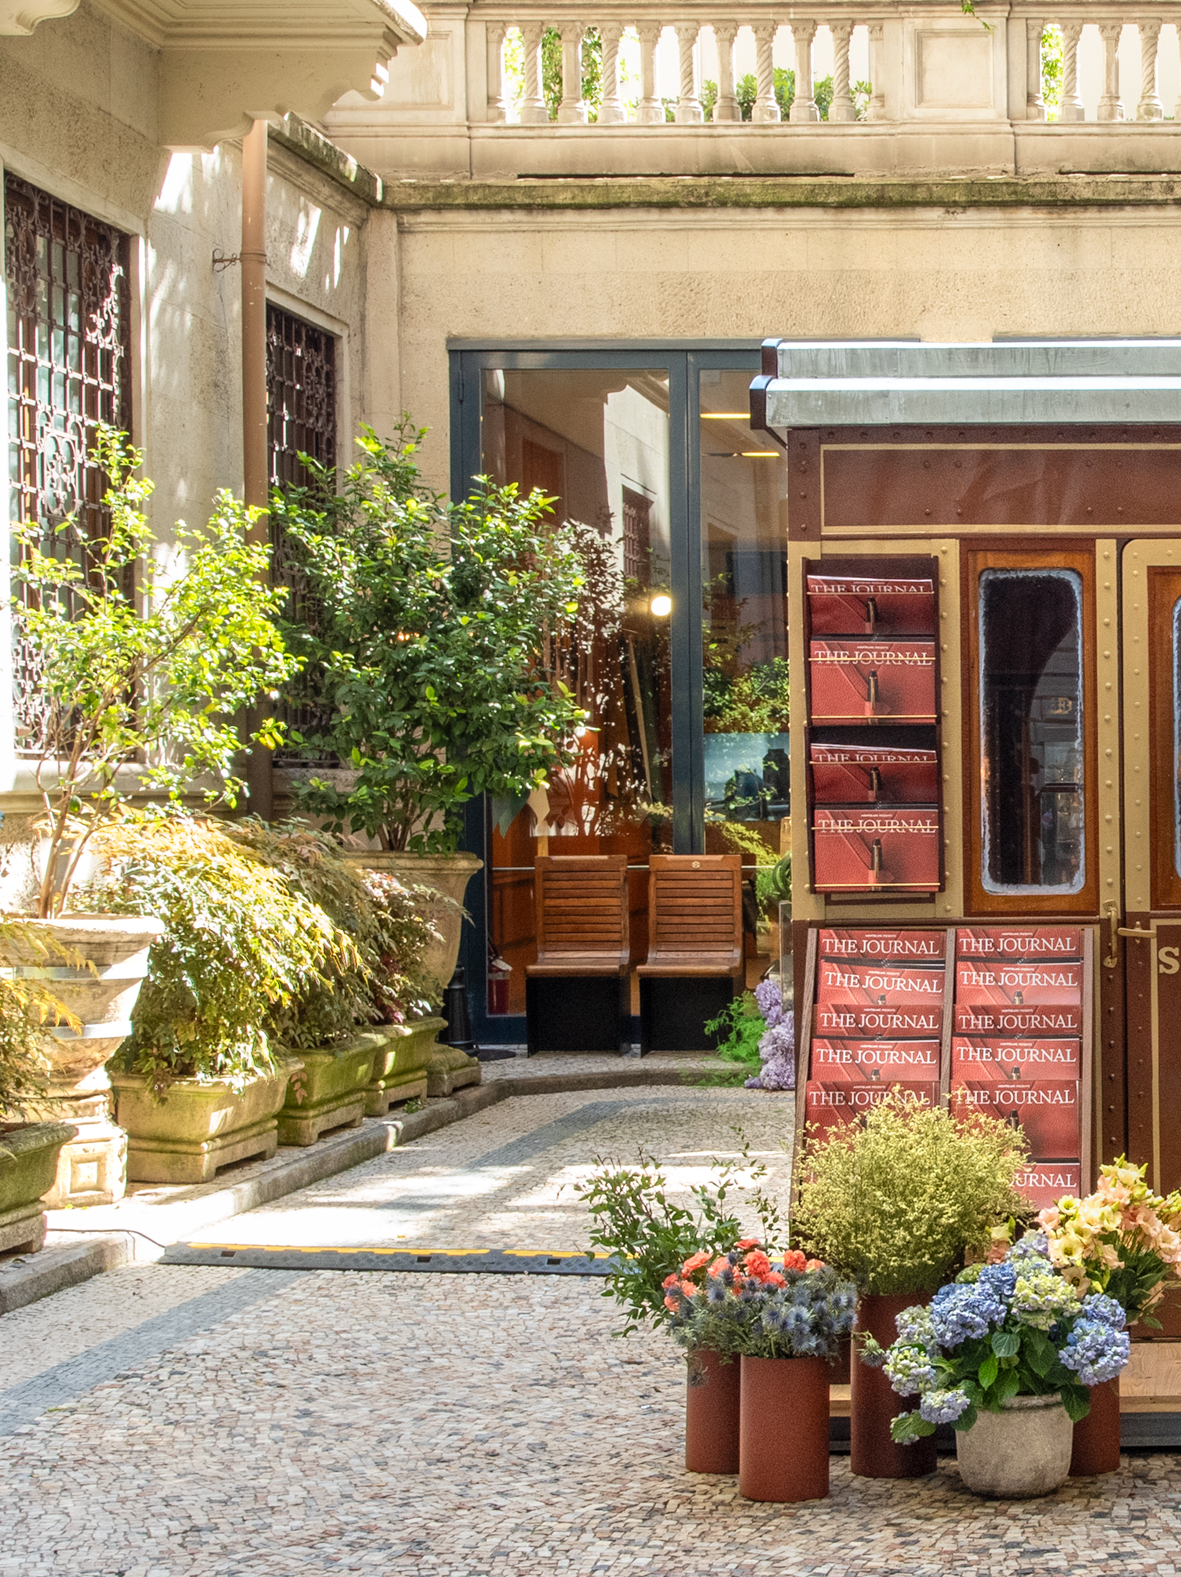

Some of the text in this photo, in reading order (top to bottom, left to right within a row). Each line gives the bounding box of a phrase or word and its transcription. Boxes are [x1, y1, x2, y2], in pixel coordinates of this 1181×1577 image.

[814, 651, 932, 665] THE JOURNAL
[818, 819, 936, 834] THE JOURNAL
[822, 938, 940, 954] THE JOURNAL
[959, 937, 1076, 952] THE JOURNAL
[824, 971, 942, 993] THE JOURNAL
[960, 971, 1078, 986] THE JOURNAL
[820, 1012, 939, 1028] THE JOURNAL
[958, 1014, 1077, 1029] THE JOURNAL
[816, 1048, 936, 1064] THE JOURNAL
[956, 1046, 1076, 1063] THE JOURNAL
[809, 1091, 845, 1105] THE
[993, 1089, 1074, 1104] JOURNAL
[1009, 1173, 1077, 1188] URNAL
